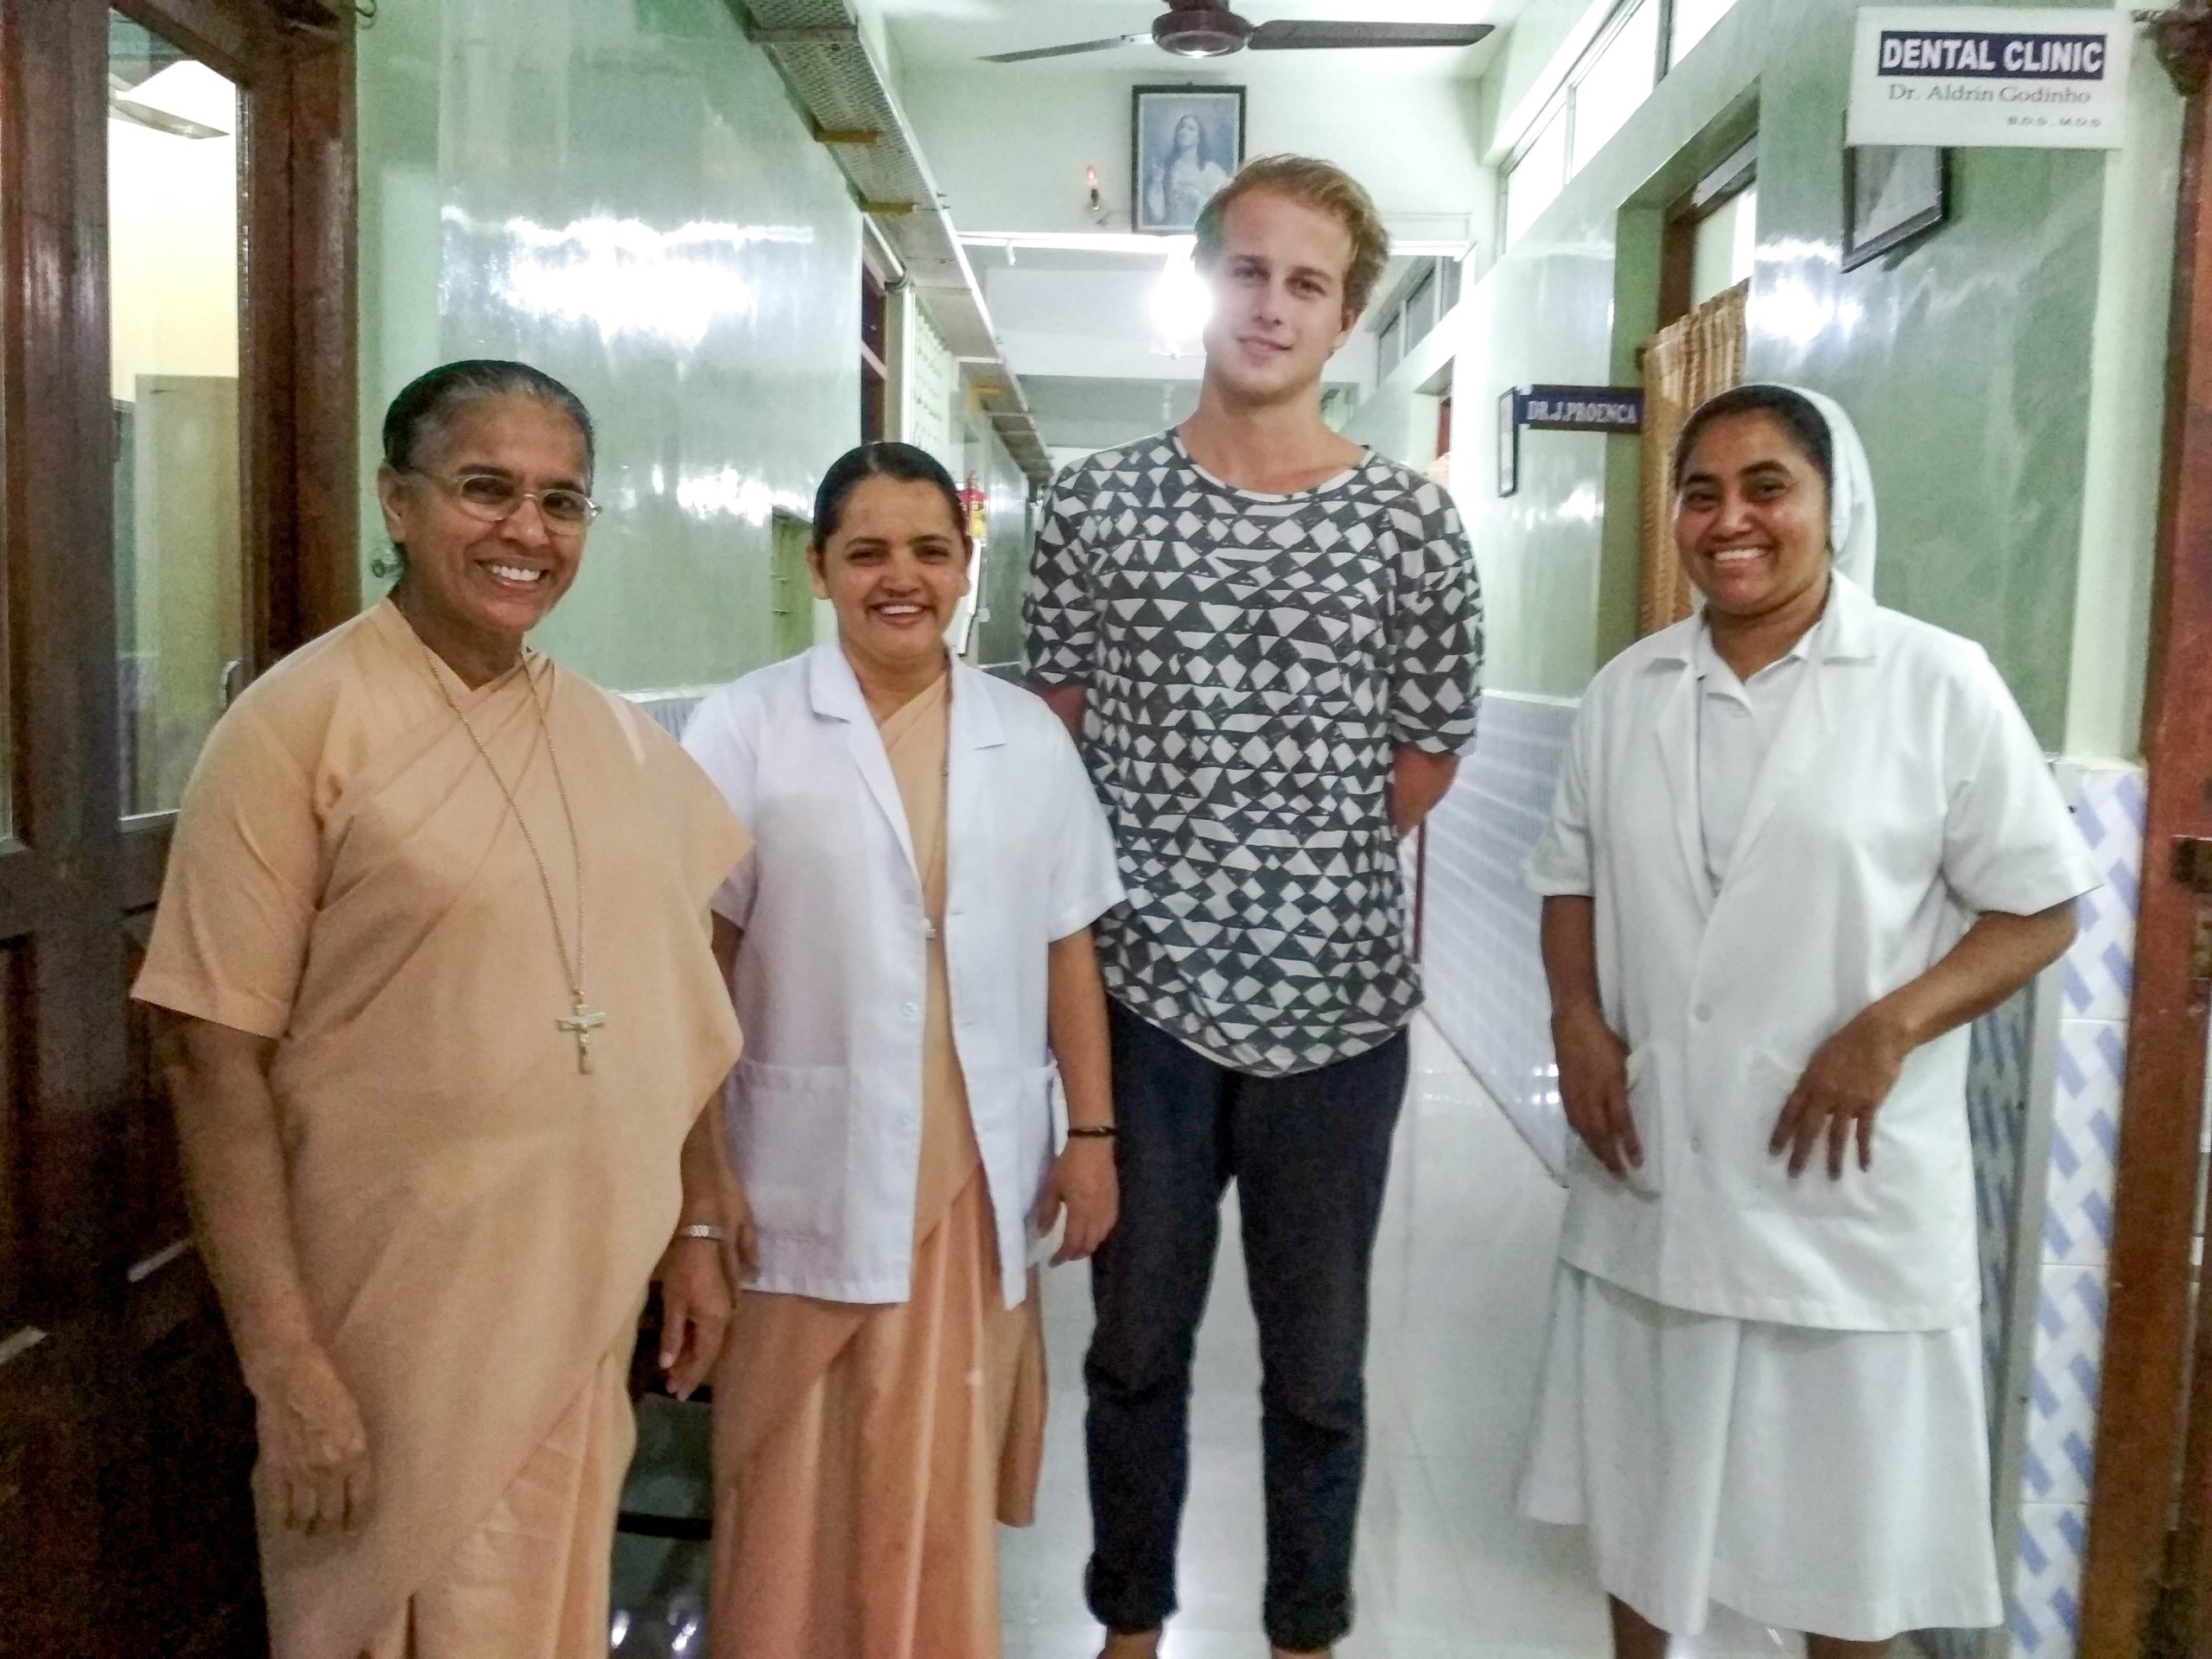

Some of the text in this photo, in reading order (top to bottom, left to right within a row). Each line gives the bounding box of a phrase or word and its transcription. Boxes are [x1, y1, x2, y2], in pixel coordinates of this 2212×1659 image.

[1881, 38, 2103, 73] DENTAL CLINIC
[1888, 84, 2092, 104] Dr. Aldrin Godinho
